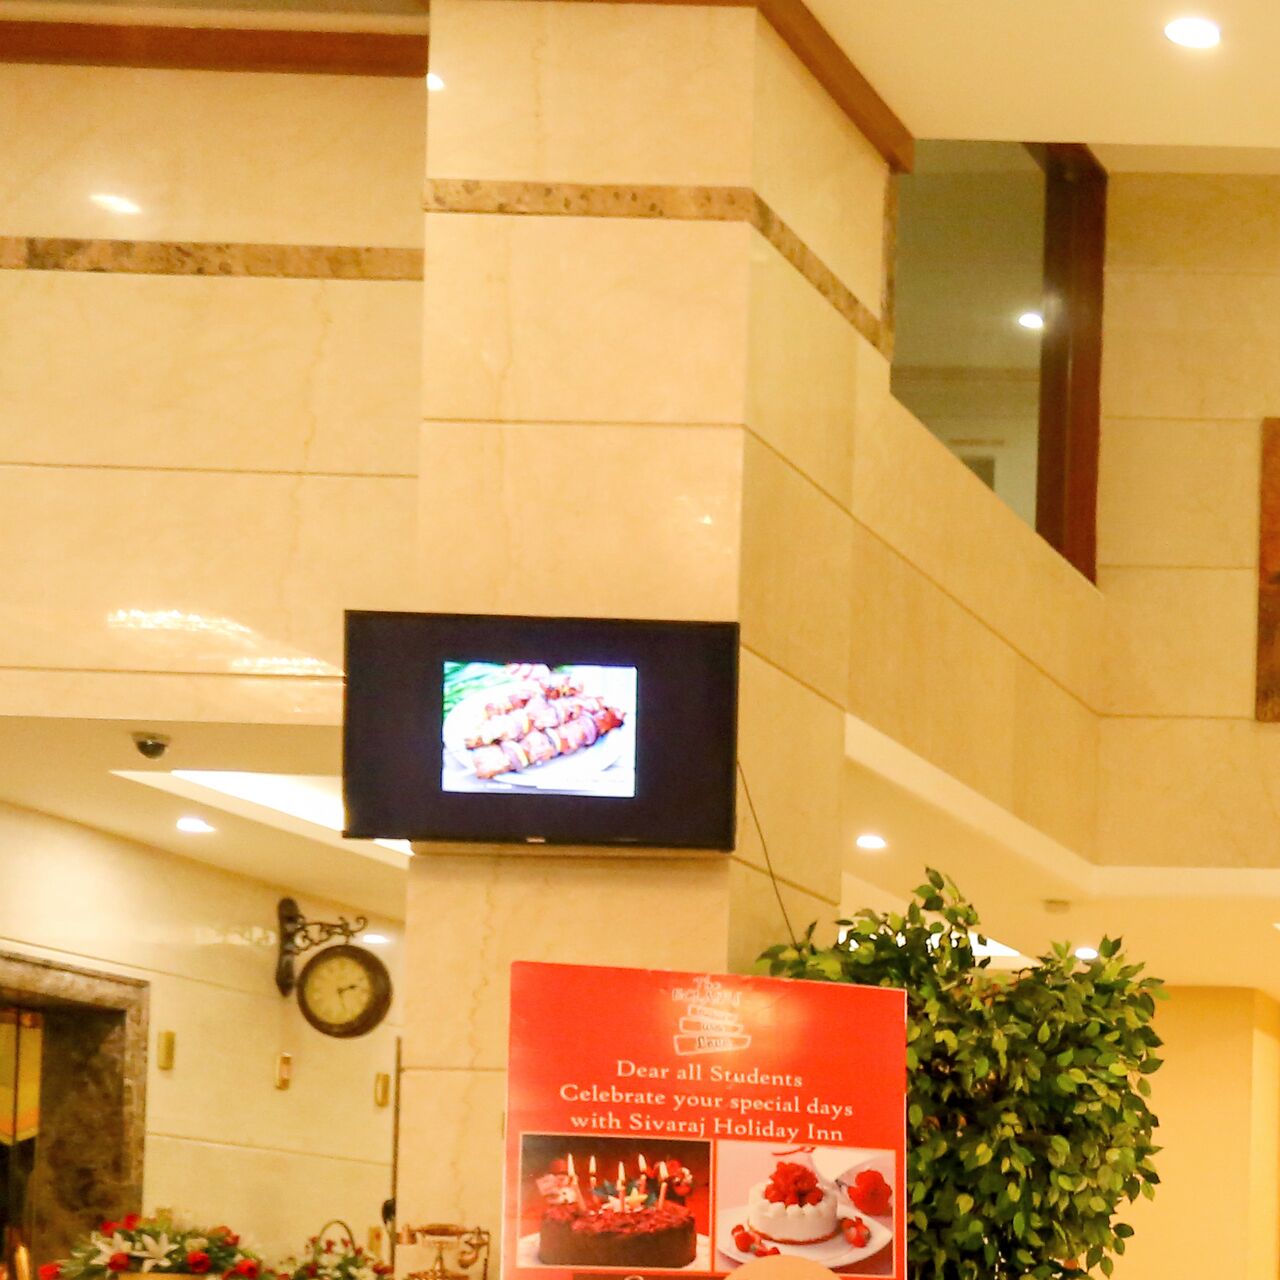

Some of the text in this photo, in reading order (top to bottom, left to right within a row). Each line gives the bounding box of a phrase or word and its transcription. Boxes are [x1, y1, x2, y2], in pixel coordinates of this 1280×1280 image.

[616, 1060, 803, 1087] Dear all Students
[559, 1084, 853, 1120] Celebrate your special days
[570, 1113, 843, 1144] with Sivaraj Holiday Inn
